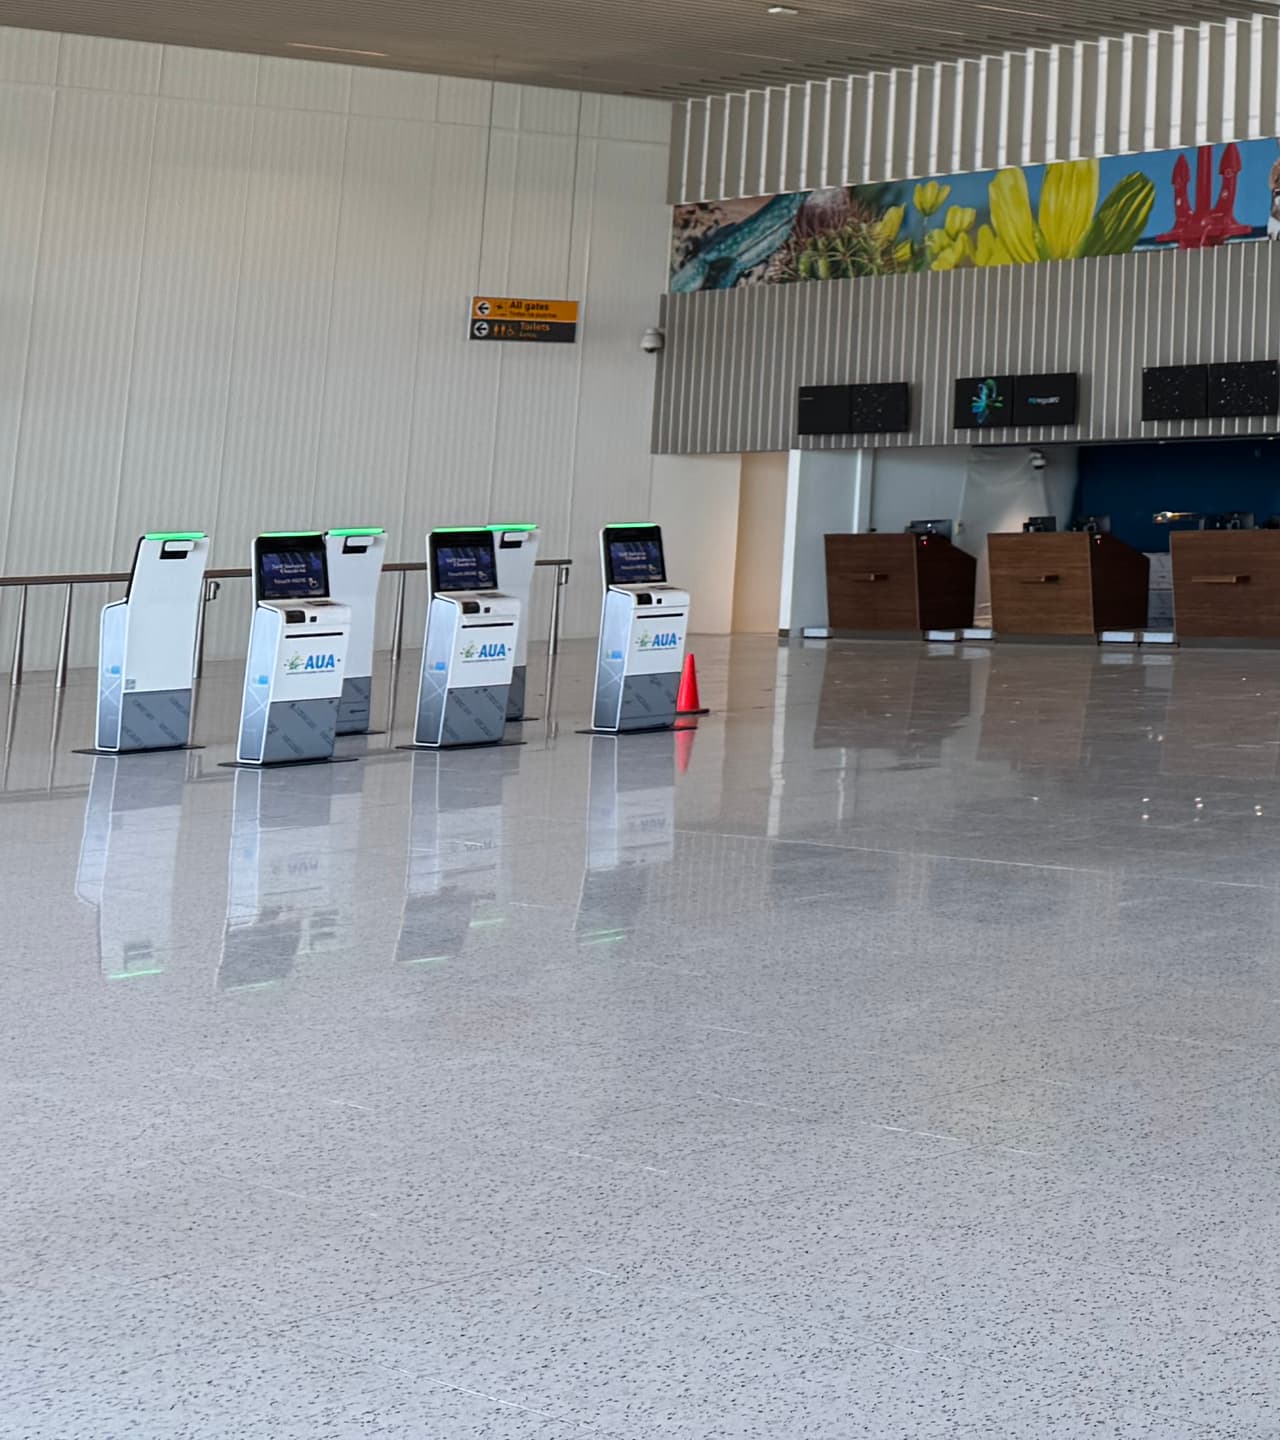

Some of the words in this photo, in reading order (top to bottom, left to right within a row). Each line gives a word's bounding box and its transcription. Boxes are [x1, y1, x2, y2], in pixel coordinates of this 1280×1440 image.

[652, 632, 678, 647] AUA
[478, 643, 507, 659] AUA
[304, 653, 336, 671] AUA
